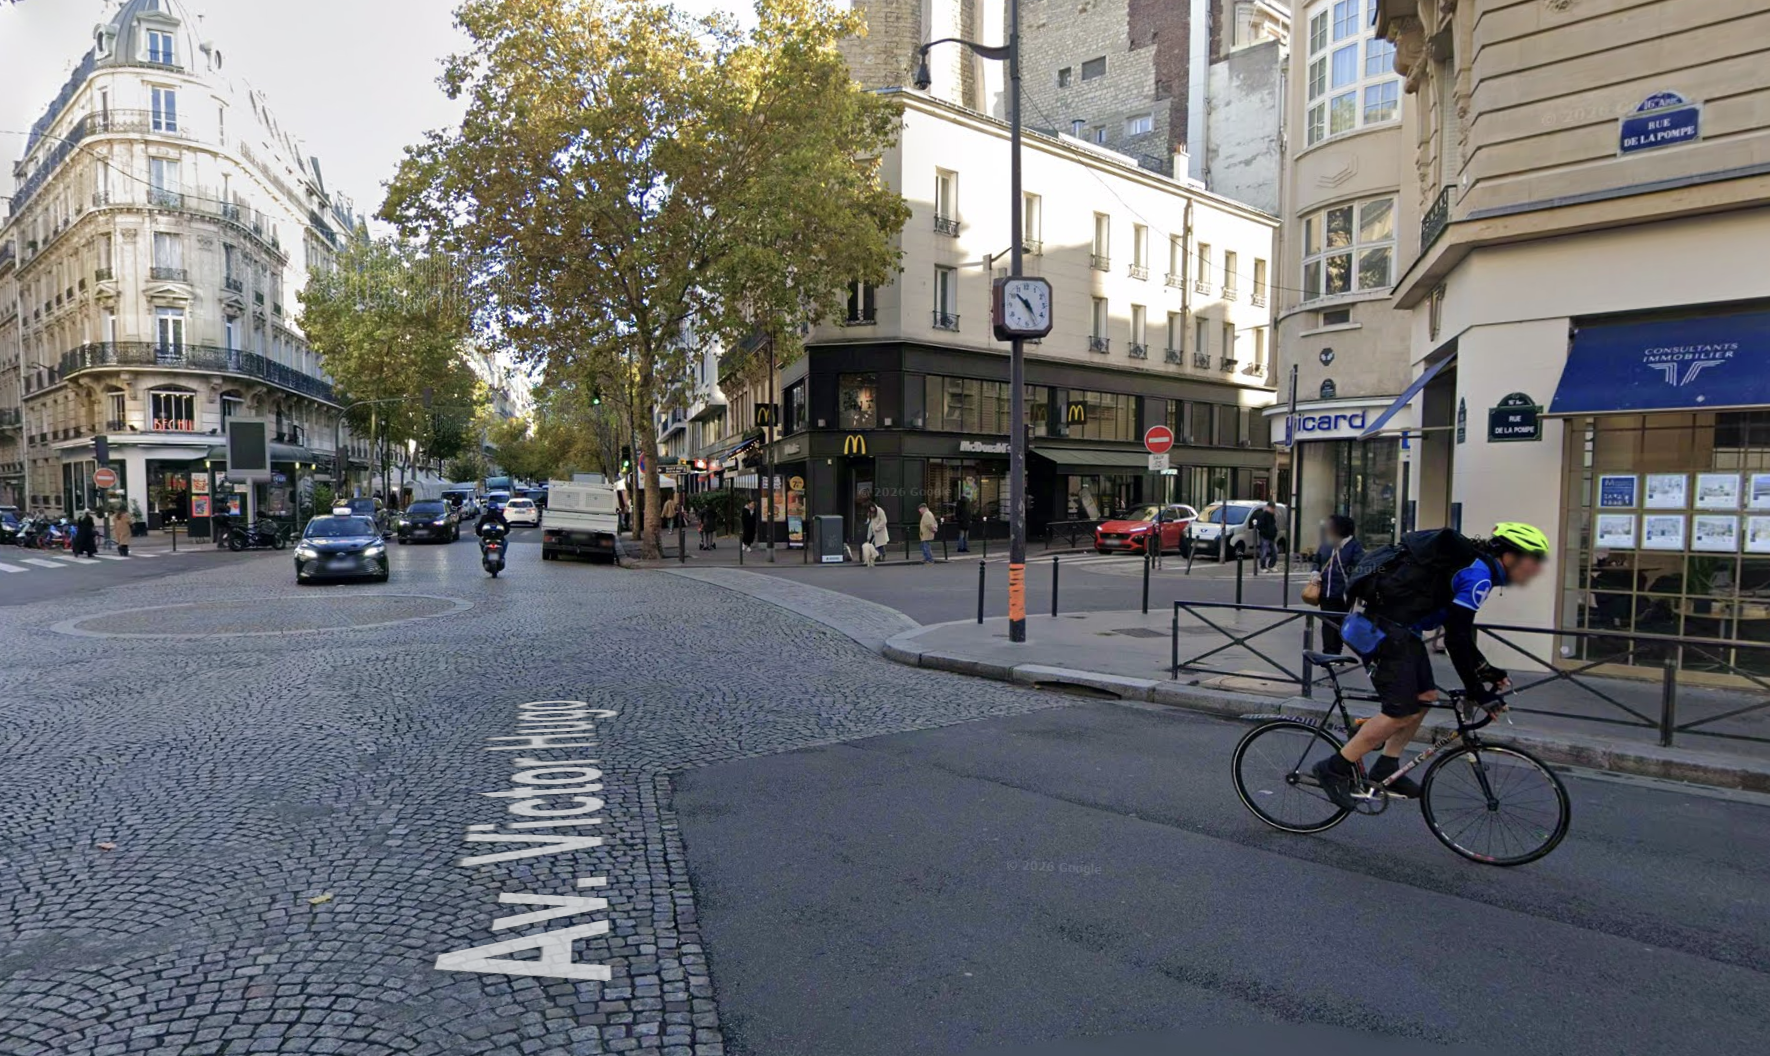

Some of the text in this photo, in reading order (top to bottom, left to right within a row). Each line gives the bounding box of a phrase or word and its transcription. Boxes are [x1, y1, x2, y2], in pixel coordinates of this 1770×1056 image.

[1648, 118, 1671, 130] RUE
[1623, 125, 1695, 147] DE LA POMPE
[1644, 342, 1739, 356] CONSULTANTS
[1642, 350, 1735, 363] IMMOBILIER
[1296, 408, 1367, 432] icard
[1508, 415, 1522, 423] RUE
[1504, 426, 1513, 434] LA
[1513, 425, 1535, 434] POMPE
[434, 700, 618, 981] Av. Victor Hugo
